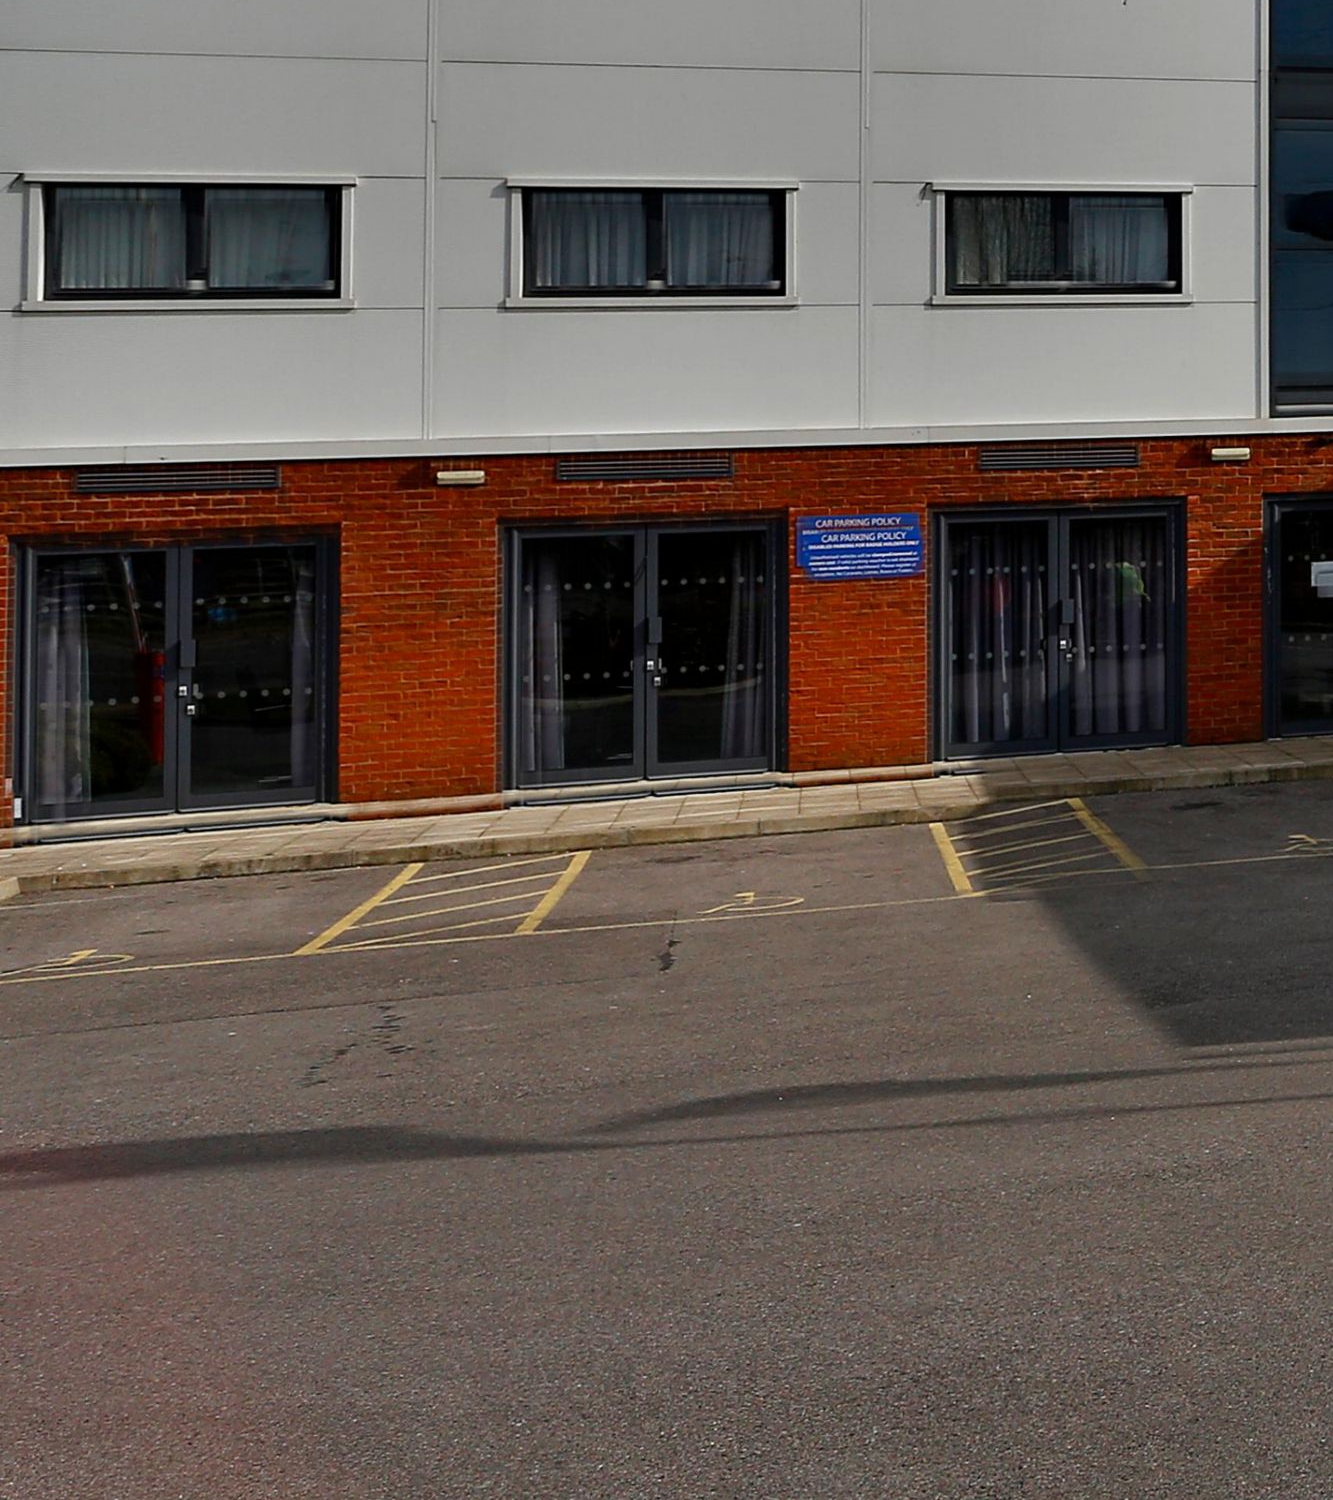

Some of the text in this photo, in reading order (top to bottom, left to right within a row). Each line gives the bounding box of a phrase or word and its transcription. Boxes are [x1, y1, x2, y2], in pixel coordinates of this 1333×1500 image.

[815, 517, 902, 529] CAR PARKING POLICY
[821, 531, 907, 543] CAR PARKING POLICY
